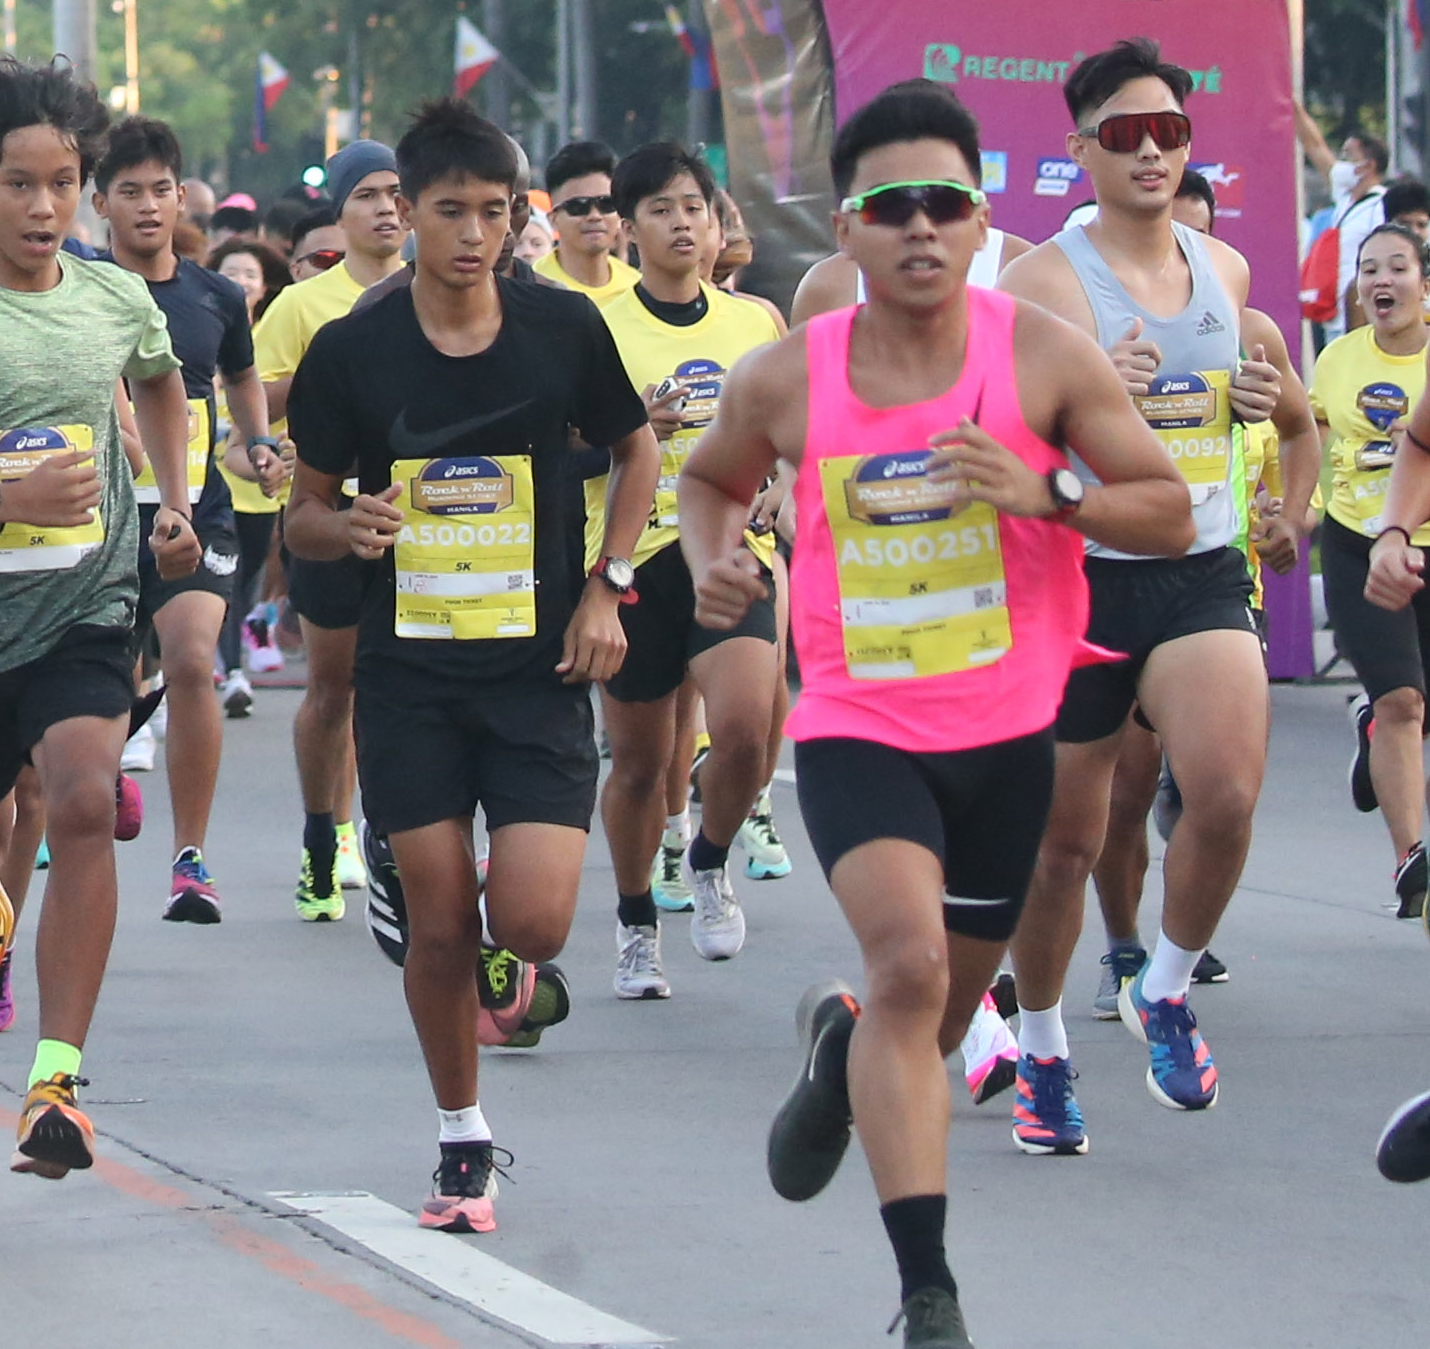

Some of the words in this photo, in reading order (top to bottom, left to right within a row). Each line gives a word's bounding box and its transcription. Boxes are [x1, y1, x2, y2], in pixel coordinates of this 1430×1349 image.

[963, 55, 1072, 83] REGENT
[1196, 323, 1226, 337] adidas
[1168, 436, 1226, 459] 0092
[29, 535, 46, 546] 5K
[396, 522, 530, 547] A500022
[840, 524, 996, 567] A500251
[455, 561, 472, 572] 5K
